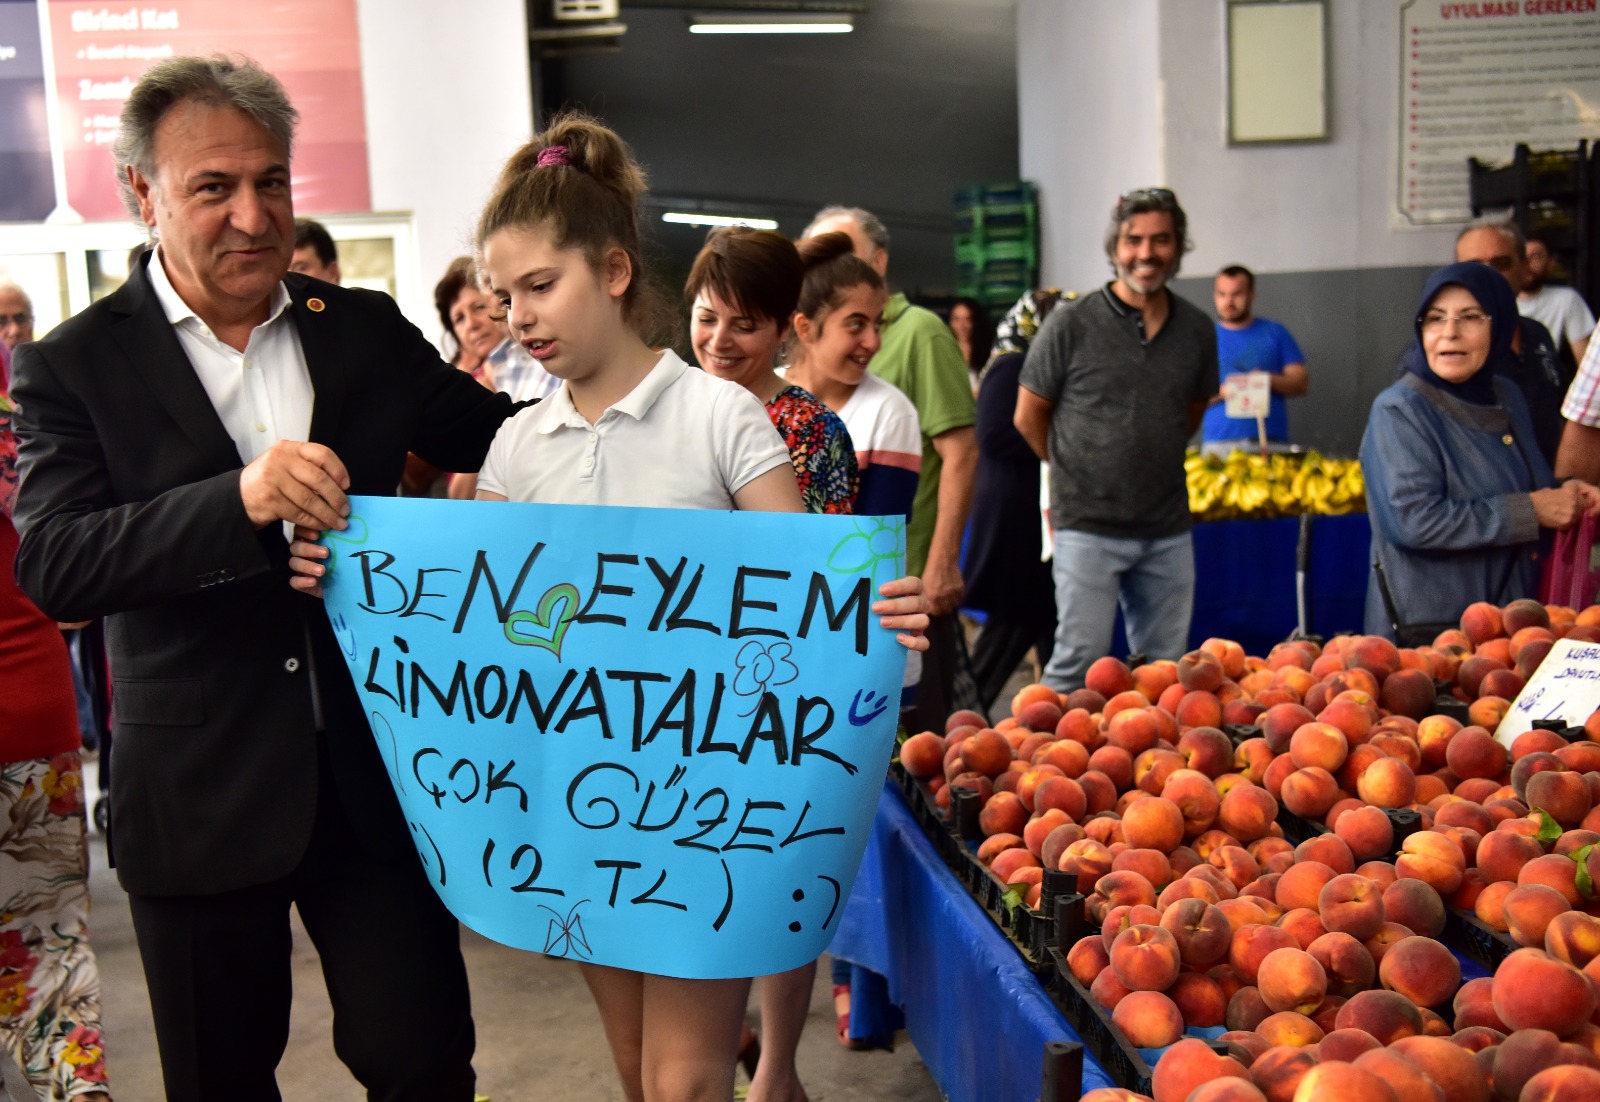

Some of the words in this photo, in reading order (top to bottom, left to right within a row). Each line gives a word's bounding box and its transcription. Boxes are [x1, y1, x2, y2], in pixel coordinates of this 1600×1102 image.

[1440, 2, 1520, 20] UYULMASI
[1524, 0, 1597, 16] GEREKEN
[348, 541, 547, 634] BEN
[561, 552, 871, 656] EYLEM
[364, 635, 858, 776] LİMONATALAR
[412, 747, 529, 814] ÇOK
[565, 761, 846, 854] GÜZEL
